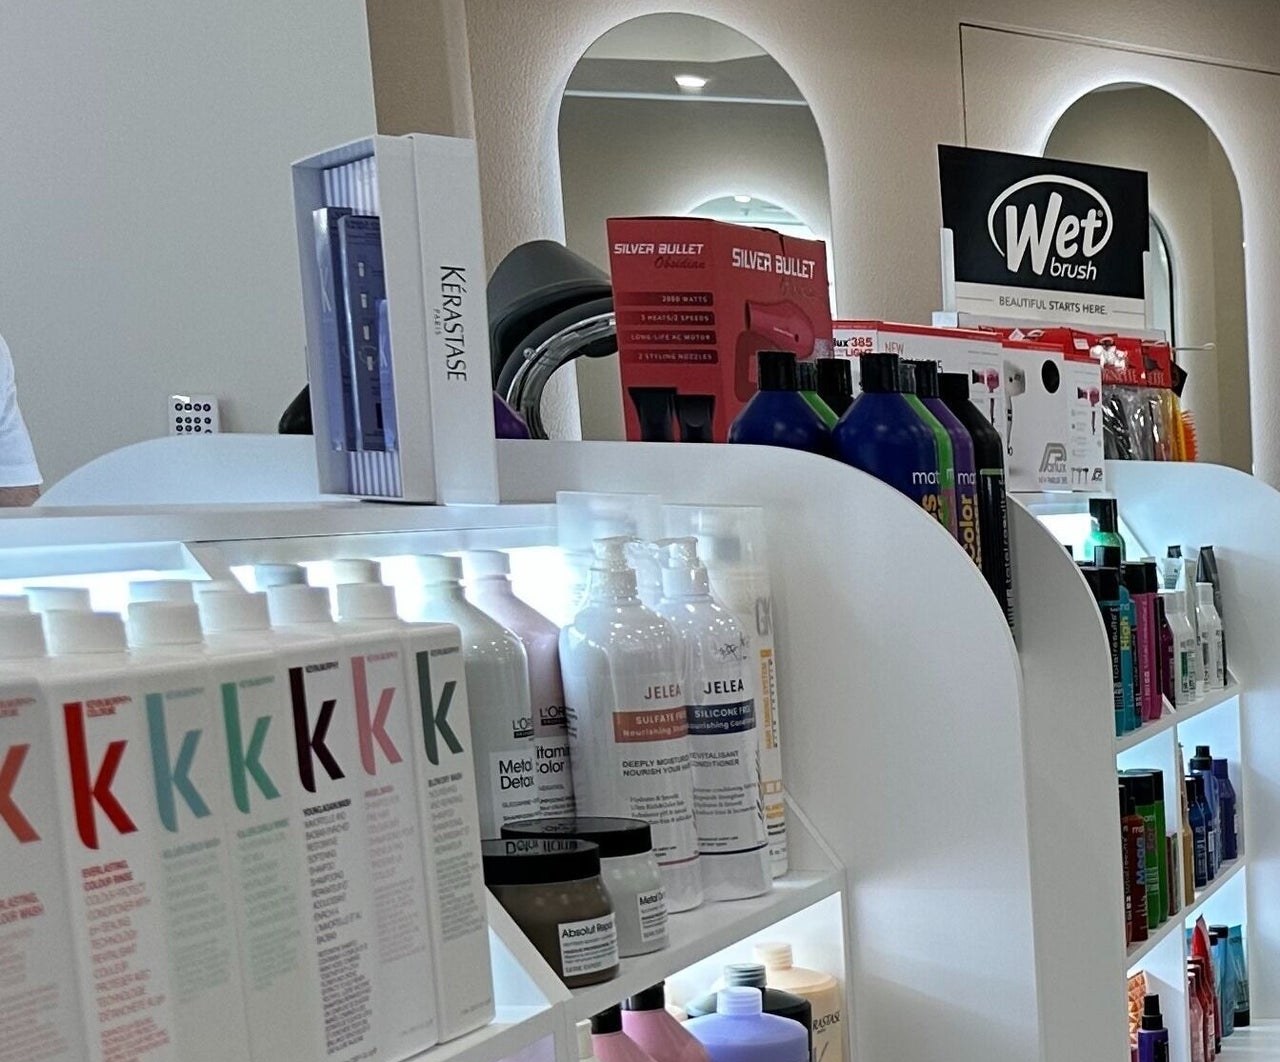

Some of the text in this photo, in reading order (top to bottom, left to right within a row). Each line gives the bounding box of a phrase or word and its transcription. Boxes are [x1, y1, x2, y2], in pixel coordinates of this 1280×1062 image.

[1005, 192, 1102, 275] Wet
[614, 243, 704, 254] SILVER BULLET
[732, 248, 815, 279] SILVER BULLET
[1050, 257, 1097, 281] brush
[999, 296, 1047, 310] BEAUTIFUL
[1049, 301, 1081, 313] STARTS
[433, 308, 442, 336] PARIS
[439, 265, 467, 382] KÉRASTASE
[851, 337, 873, 348] 385
[1120, 615, 1131, 650] High
[644, 684, 682, 700] JELEA
[703, 678, 745, 695] JELEA
[635, 713, 675, 726] SULFATE
[694, 707, 739, 719] SILICONE
[622, 759, 656, 768] DEEPLY
[623, 768, 662, 777] NOURISH
[562, 924, 595, 938] Absolut
